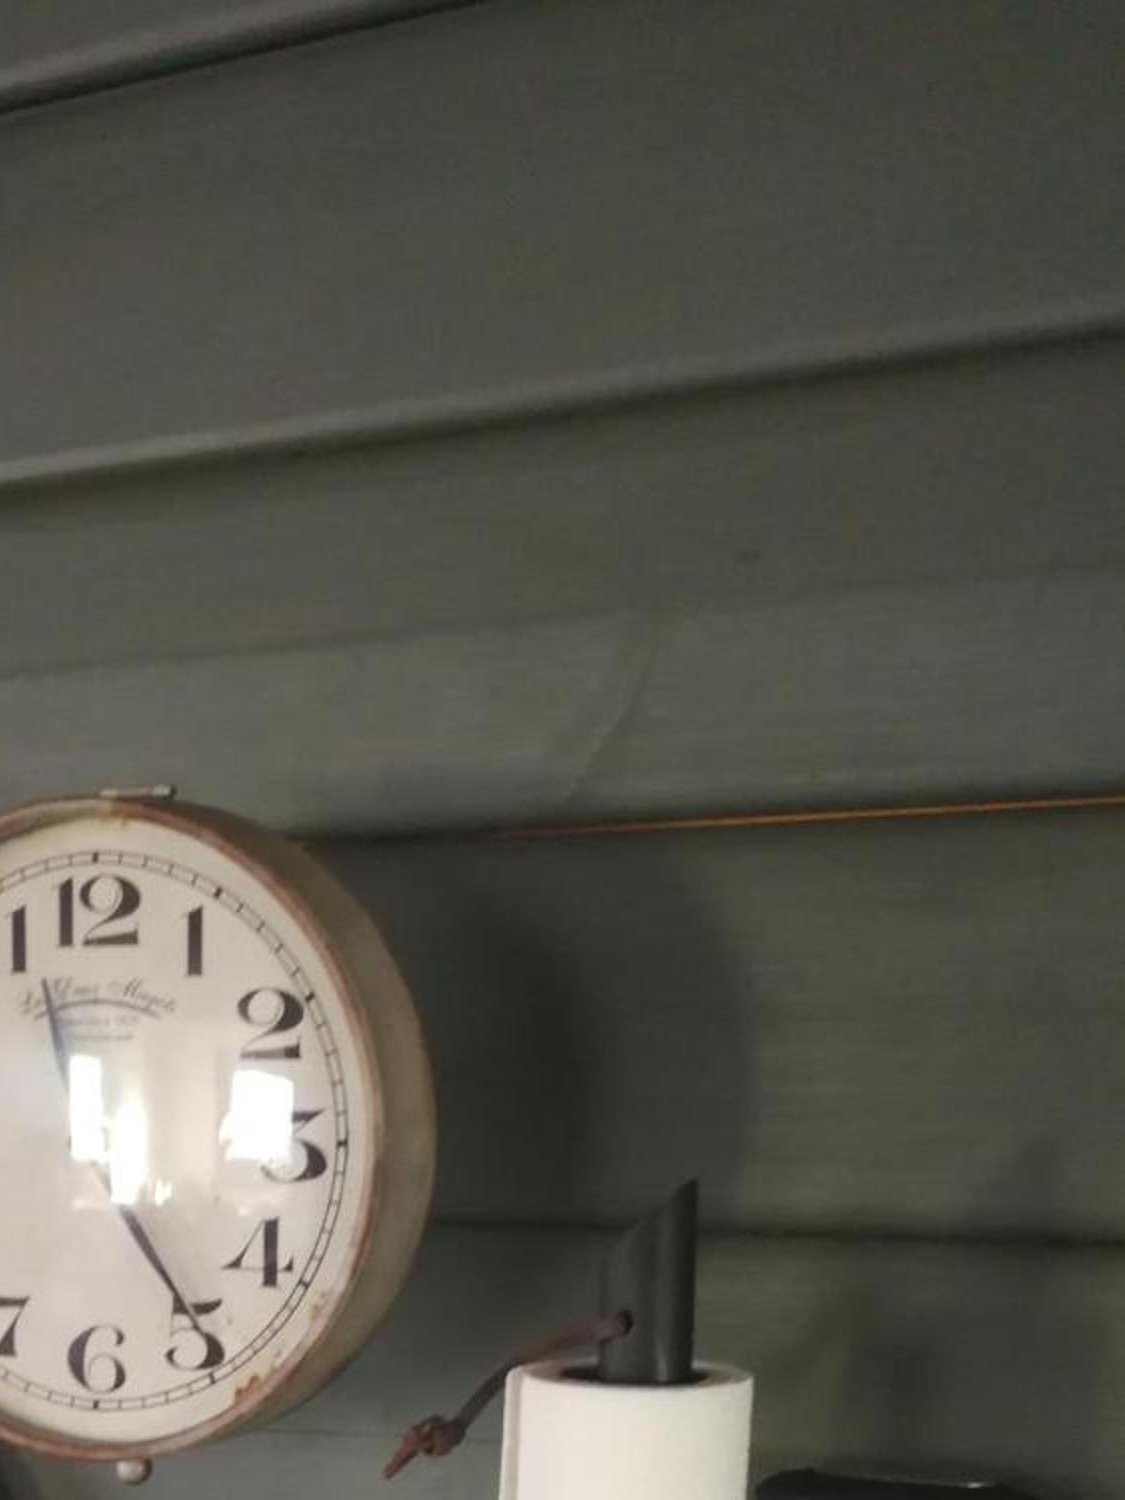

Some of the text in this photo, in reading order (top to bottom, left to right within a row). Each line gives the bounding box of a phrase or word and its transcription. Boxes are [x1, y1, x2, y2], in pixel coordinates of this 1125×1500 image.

[54, 873, 141, 947] 12
[183, 905, 204, 977] 1
[237, 986, 305, 1061] 2
[221, 1217, 295, 1288] 4
[67, 1324, 127, 1394] 6
[164, 1298, 225, 1371] 5
